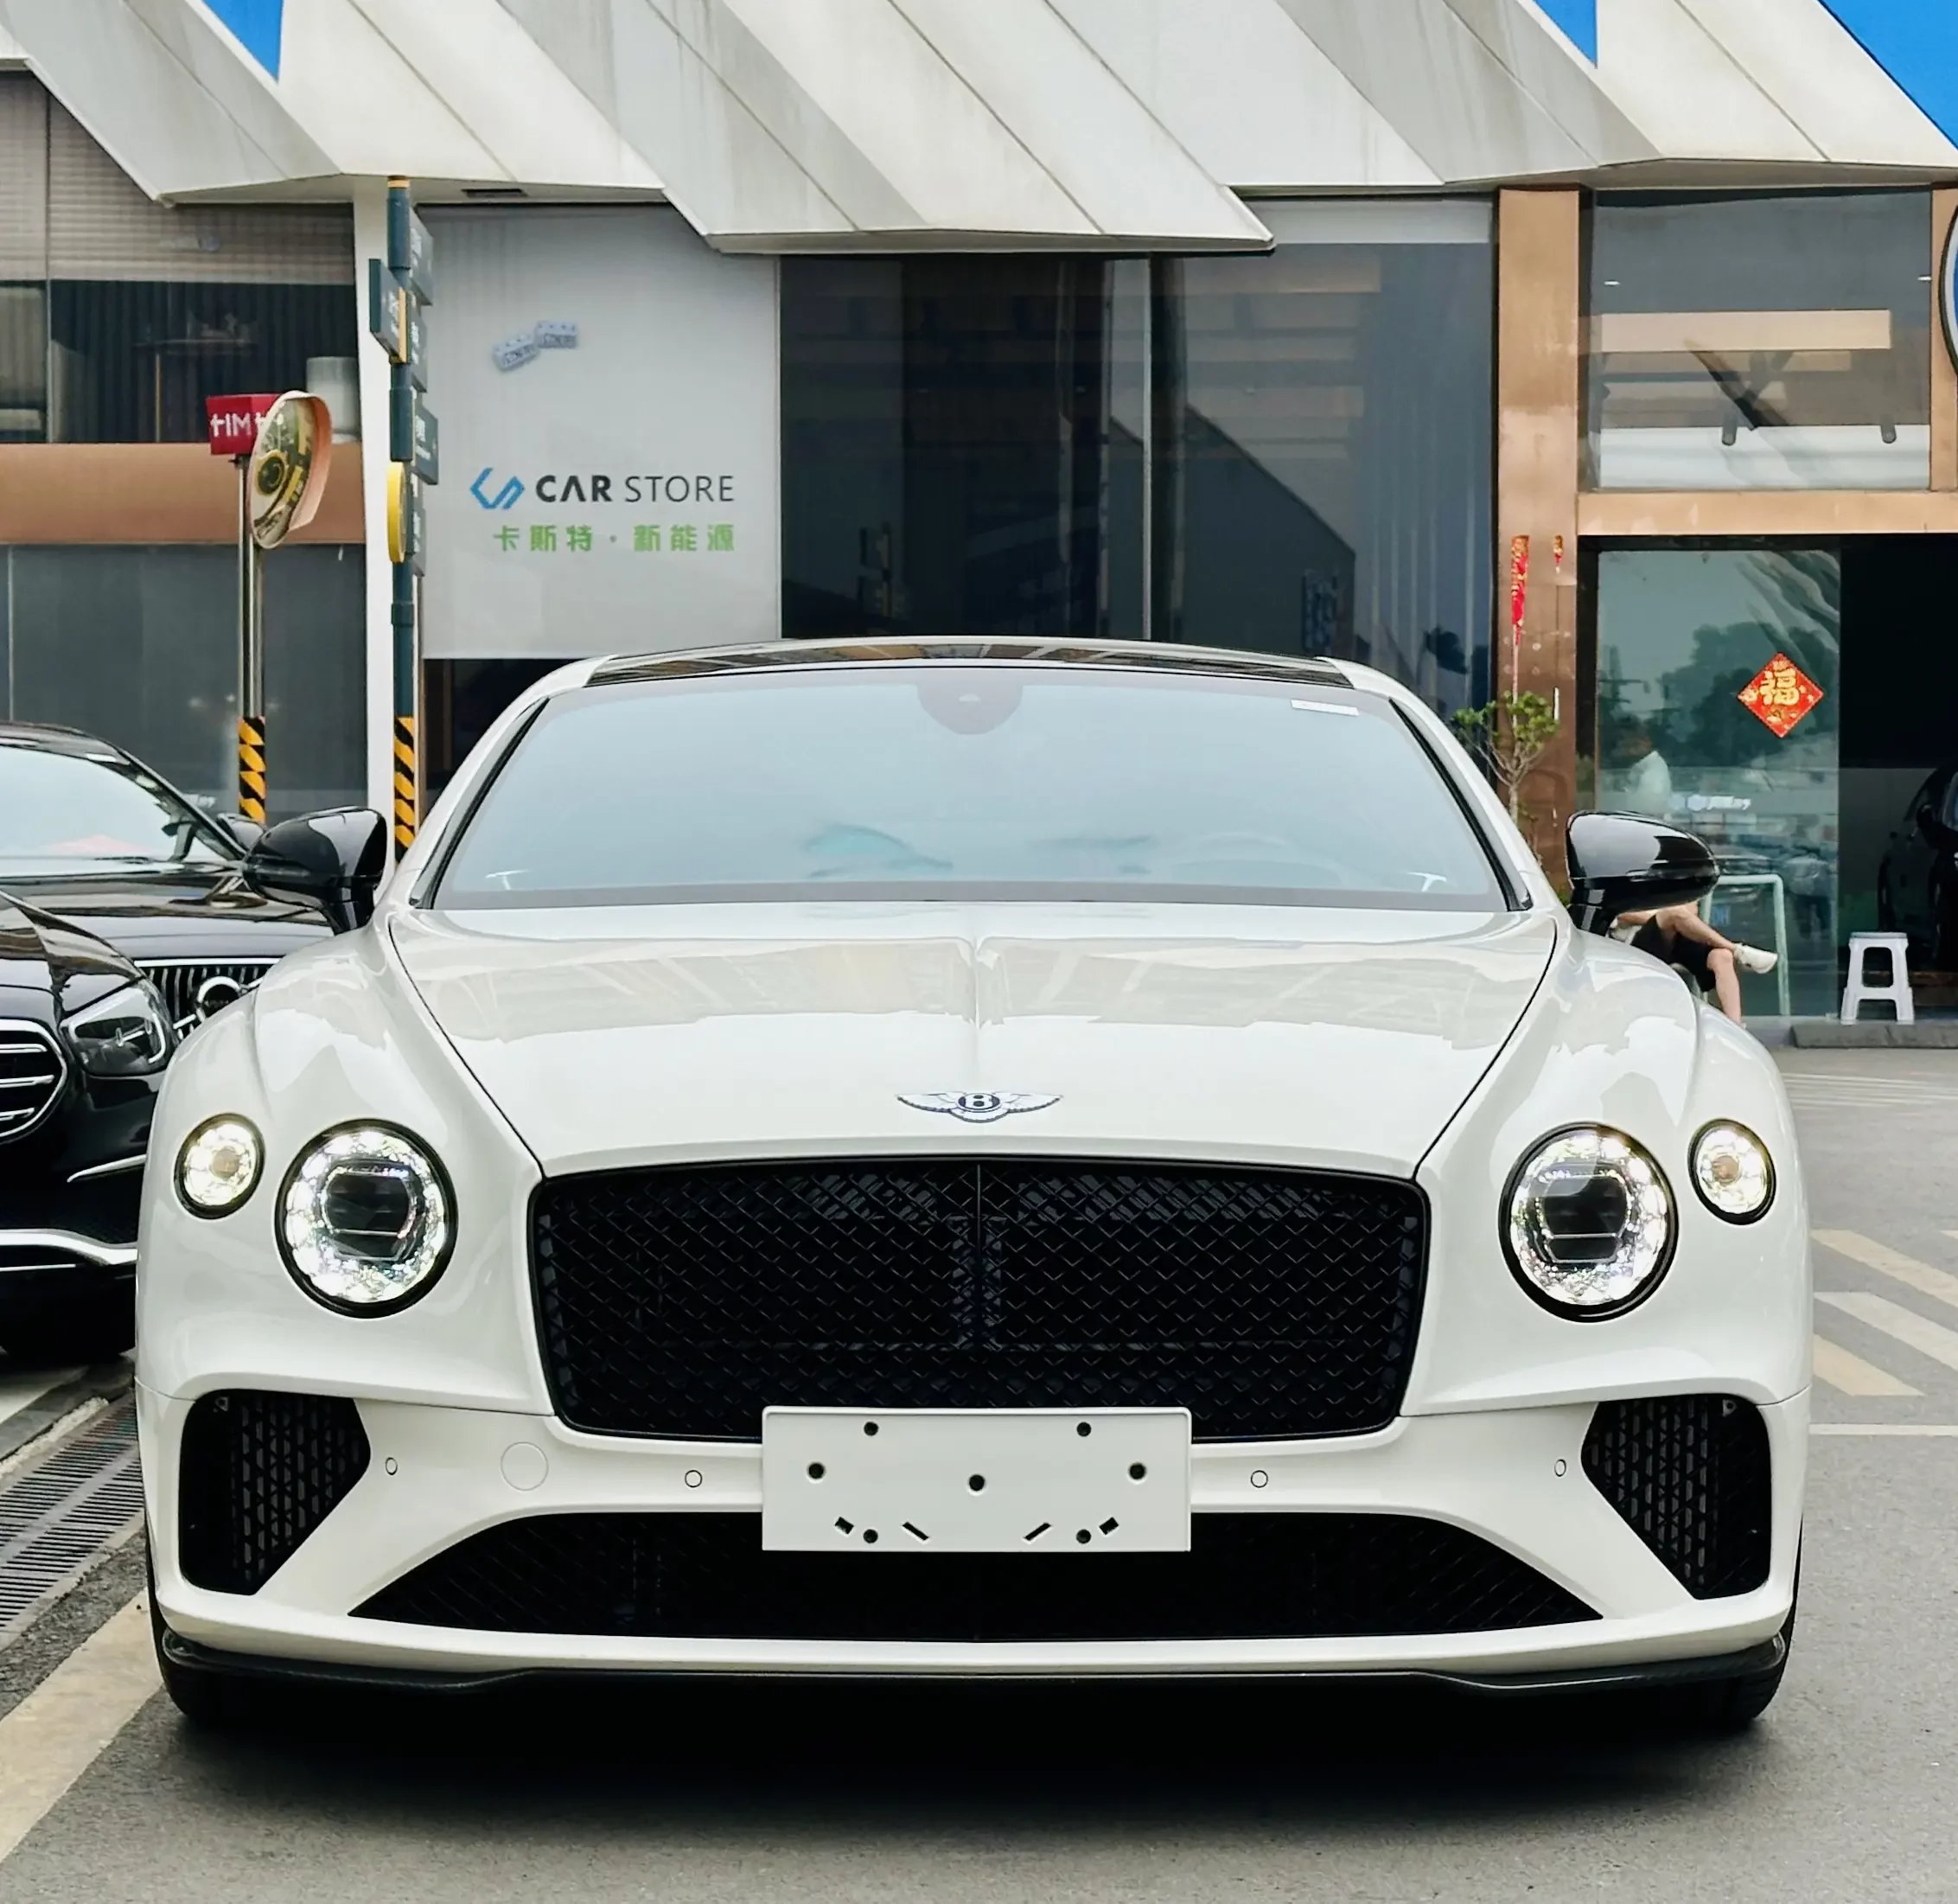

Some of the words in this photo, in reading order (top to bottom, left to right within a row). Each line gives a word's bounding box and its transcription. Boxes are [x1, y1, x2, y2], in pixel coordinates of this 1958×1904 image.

[535, 474, 612, 503] CAR
[624, 475, 735, 503] STORE
[1759, 668, 1800, 706] 福
